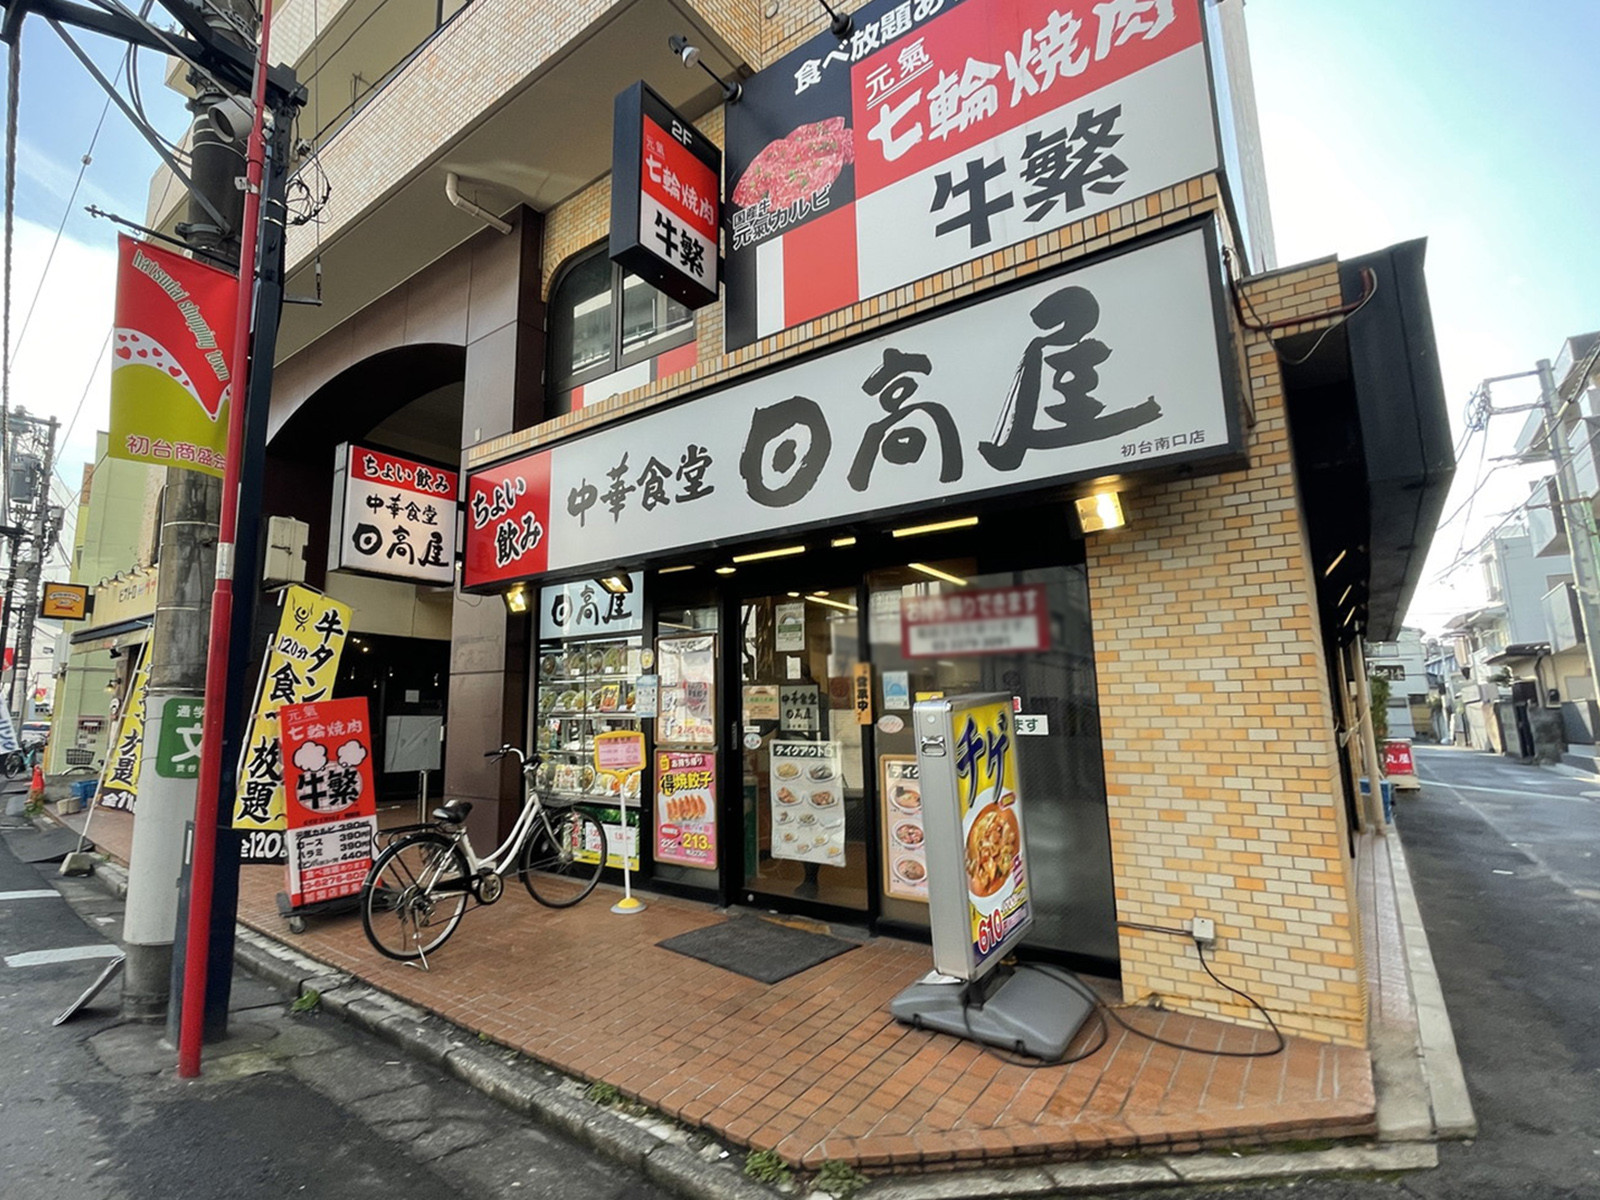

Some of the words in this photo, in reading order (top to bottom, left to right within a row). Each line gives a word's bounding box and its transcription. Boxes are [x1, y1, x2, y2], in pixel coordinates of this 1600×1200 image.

[794, 0, 954, 96] 食べ放題あ
[867, 0, 1177, 162] 七輪焼肉
[672, 120, 692, 145] 2F
[645, 154, 714, 226] 七輪焼肉
[929, 103, 1129, 249] 牛繁
[654, 209, 705, 278] 牛繁
[177, 299, 218, 349] shopping
[204, 349, 230, 382] town
[739, 285, 1163, 508] 日高屋
[1121, 429, 1205, 457] 初台南口店
[362, 453, 450, 493] ちょい飲み
[567, 443, 715, 528] 中華食堂
[366, 493, 438, 526] 中華食堂
[472, 476, 526, 530] ちょい
[352, 522, 449, 567] 日高屋
[495, 511, 543, 567] 飲み
[551, 584, 632, 628] 日高屋
[302, 608, 344, 703] 牛タン
[171, 723, 203, 763] 文
[237, 661, 302, 824] 食放題
[288, 719, 363, 741] 七輪焼肉
[775, 744, 824, 757] テイクアウト
[956, 711, 1009, 808] チゲ
[298, 768, 359, 810] 牛繁
[978, 907, 1003, 955] 610
